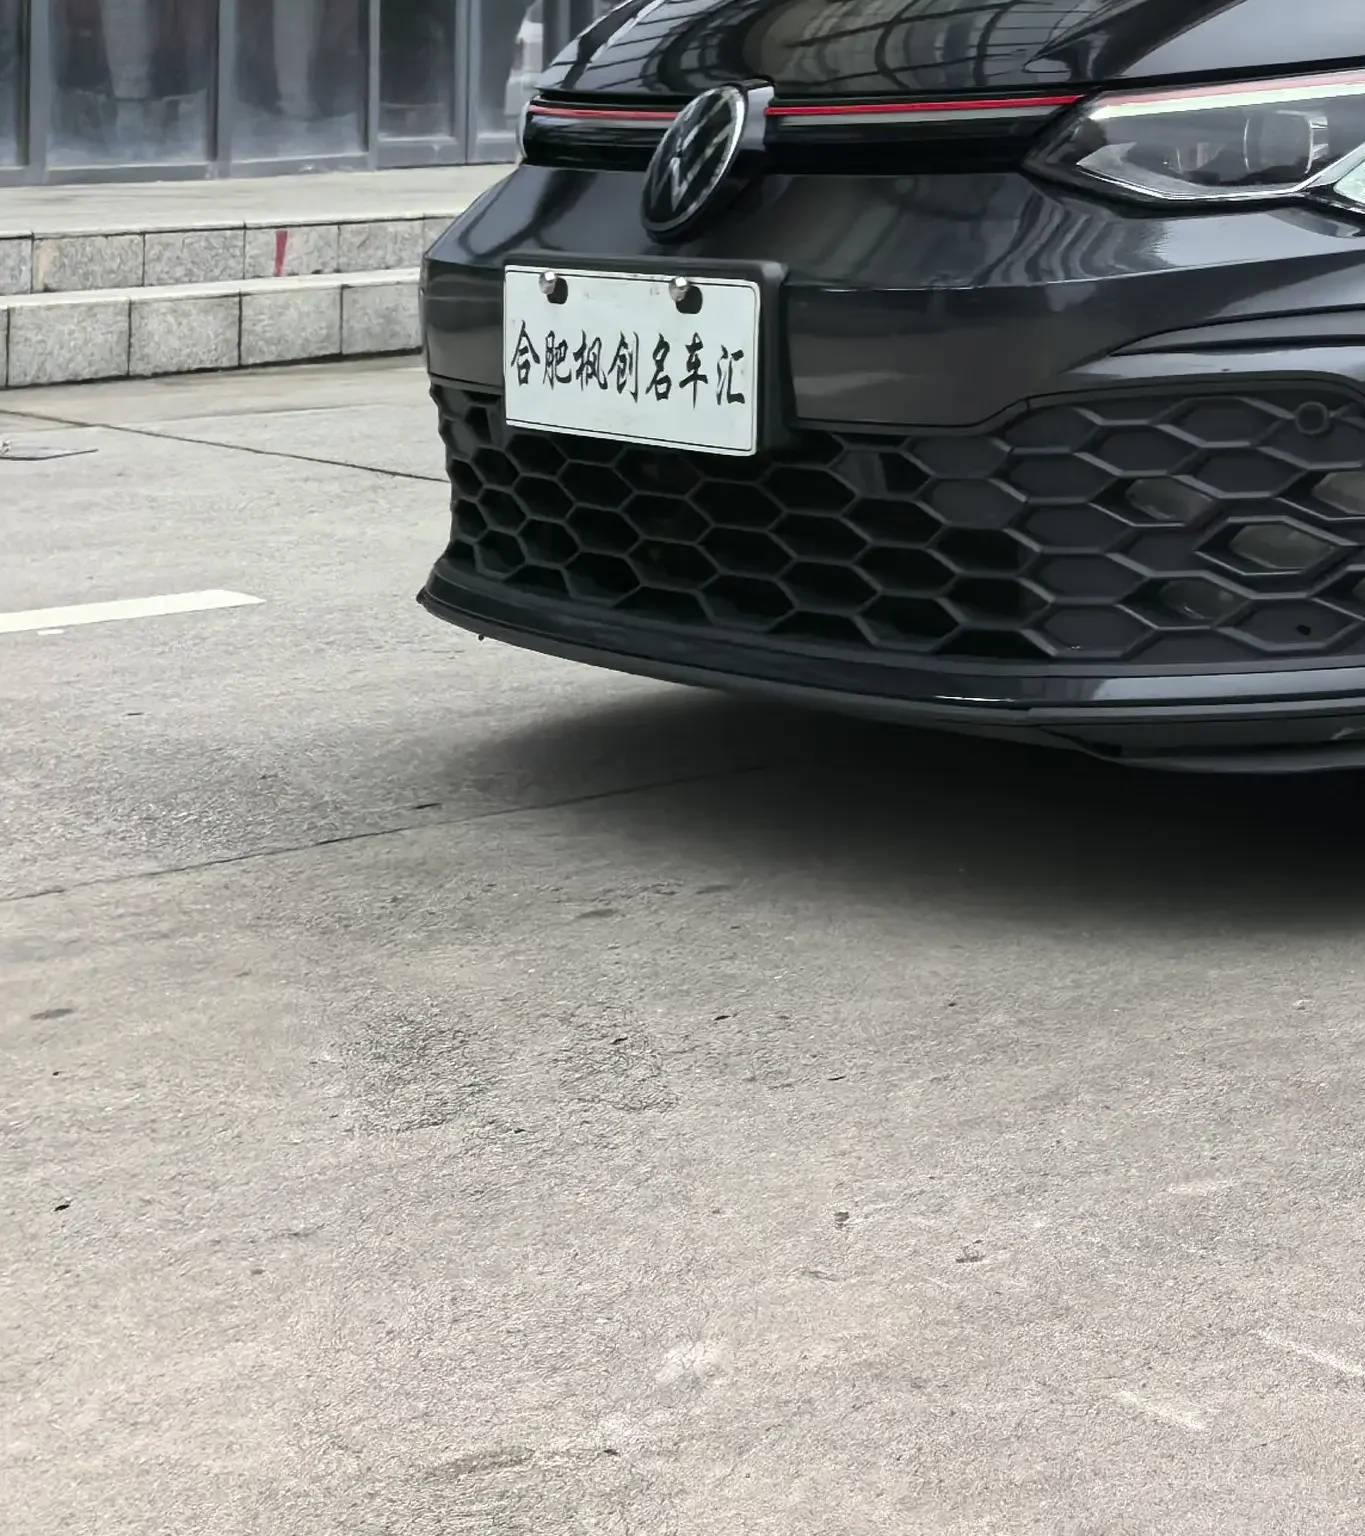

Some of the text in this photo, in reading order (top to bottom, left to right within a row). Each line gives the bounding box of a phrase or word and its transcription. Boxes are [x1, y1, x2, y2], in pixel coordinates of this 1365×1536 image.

[510, 319, 746, 411] 合肥枫创名车汇
